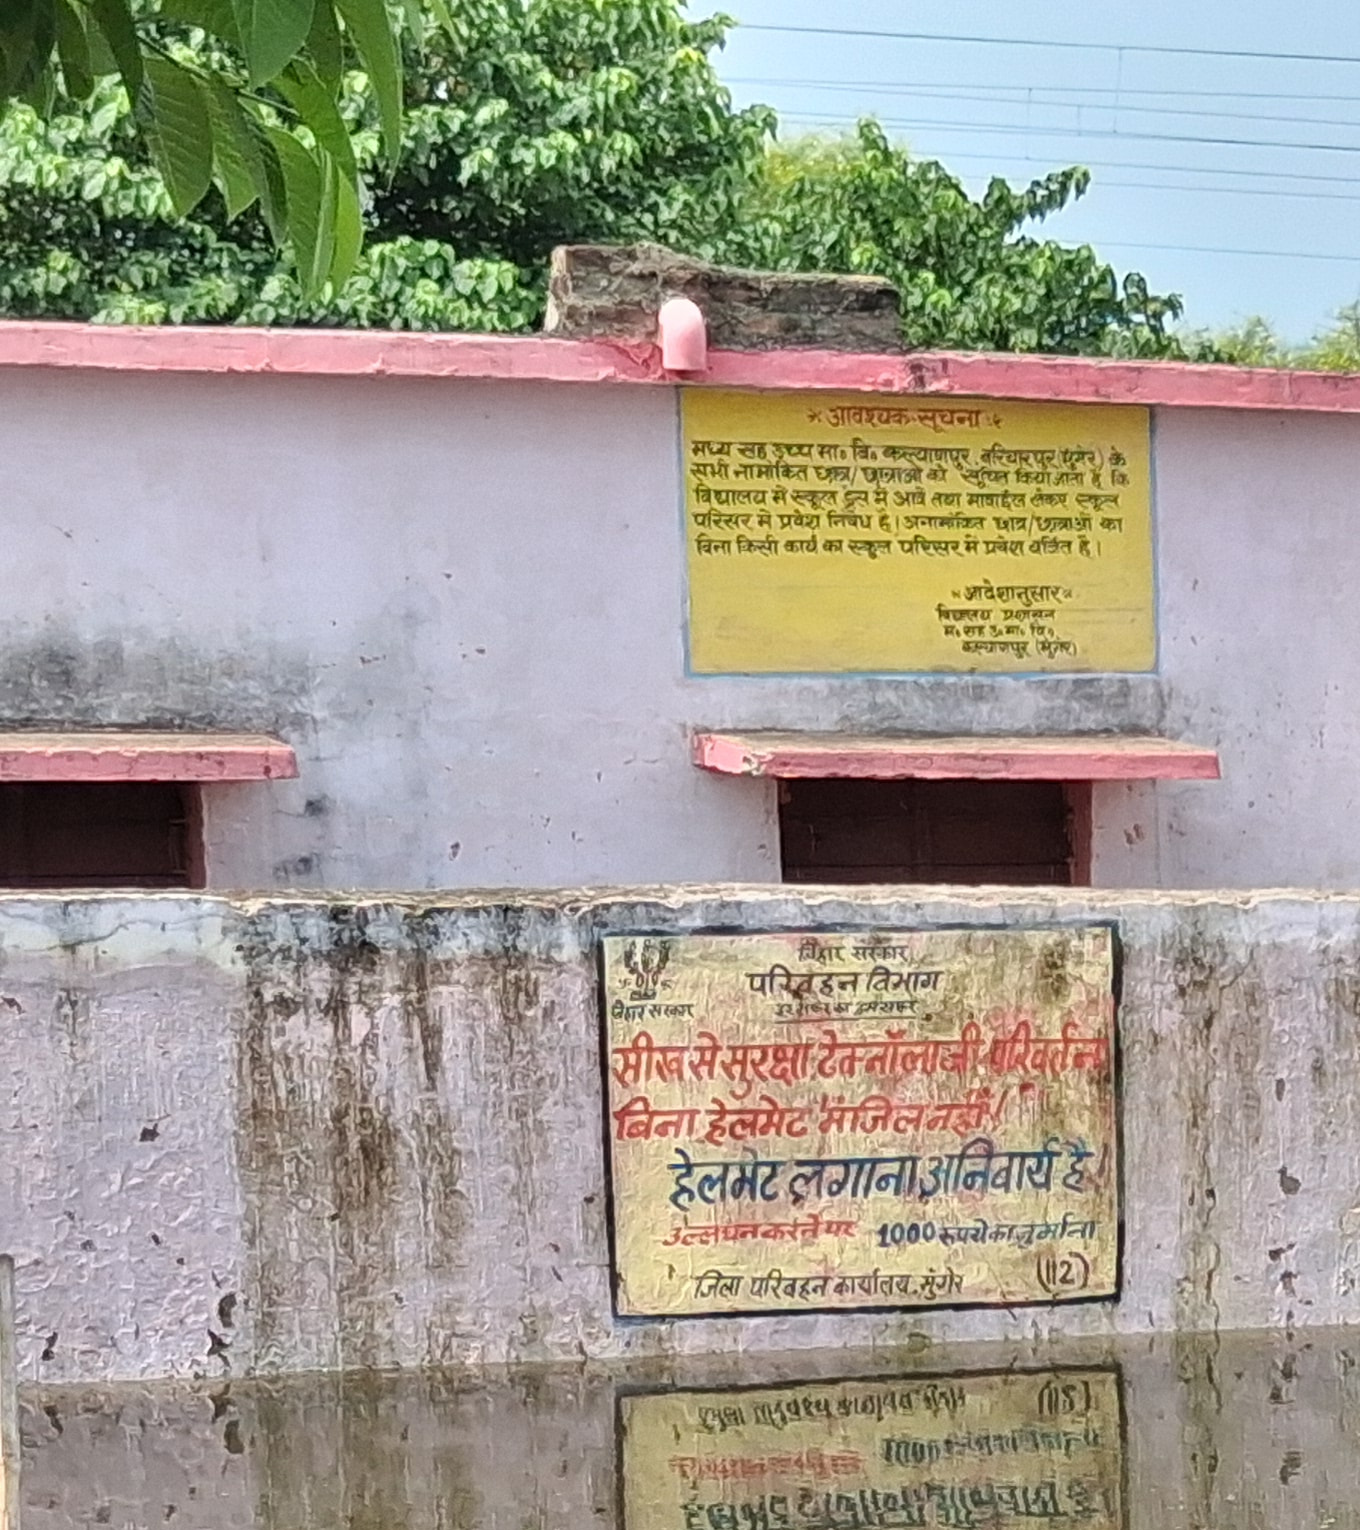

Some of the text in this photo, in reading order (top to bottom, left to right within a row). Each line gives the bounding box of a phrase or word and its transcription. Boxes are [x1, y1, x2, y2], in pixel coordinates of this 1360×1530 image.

[746, 963, 945, 998] परिवहन विभाग
[613, 1031, 688, 1088] सीख
[688, 1030, 722, 1081] से
[720, 1042, 814, 1100] सुरक्षा
[613, 1095, 701, 1141] बिना
[704, 1094, 813, 1147] हेलमेट
[667, 1146, 780, 1212] हेलमेट
[788, 1157, 921, 1206] लगाना
[918, 1137, 1062, 1200] अनिवार्य
[876, 1221, 937, 1248] 1000
[691, 1269, 745, 1300] जिला
[749, 1267, 832, 1301] परिवहन
